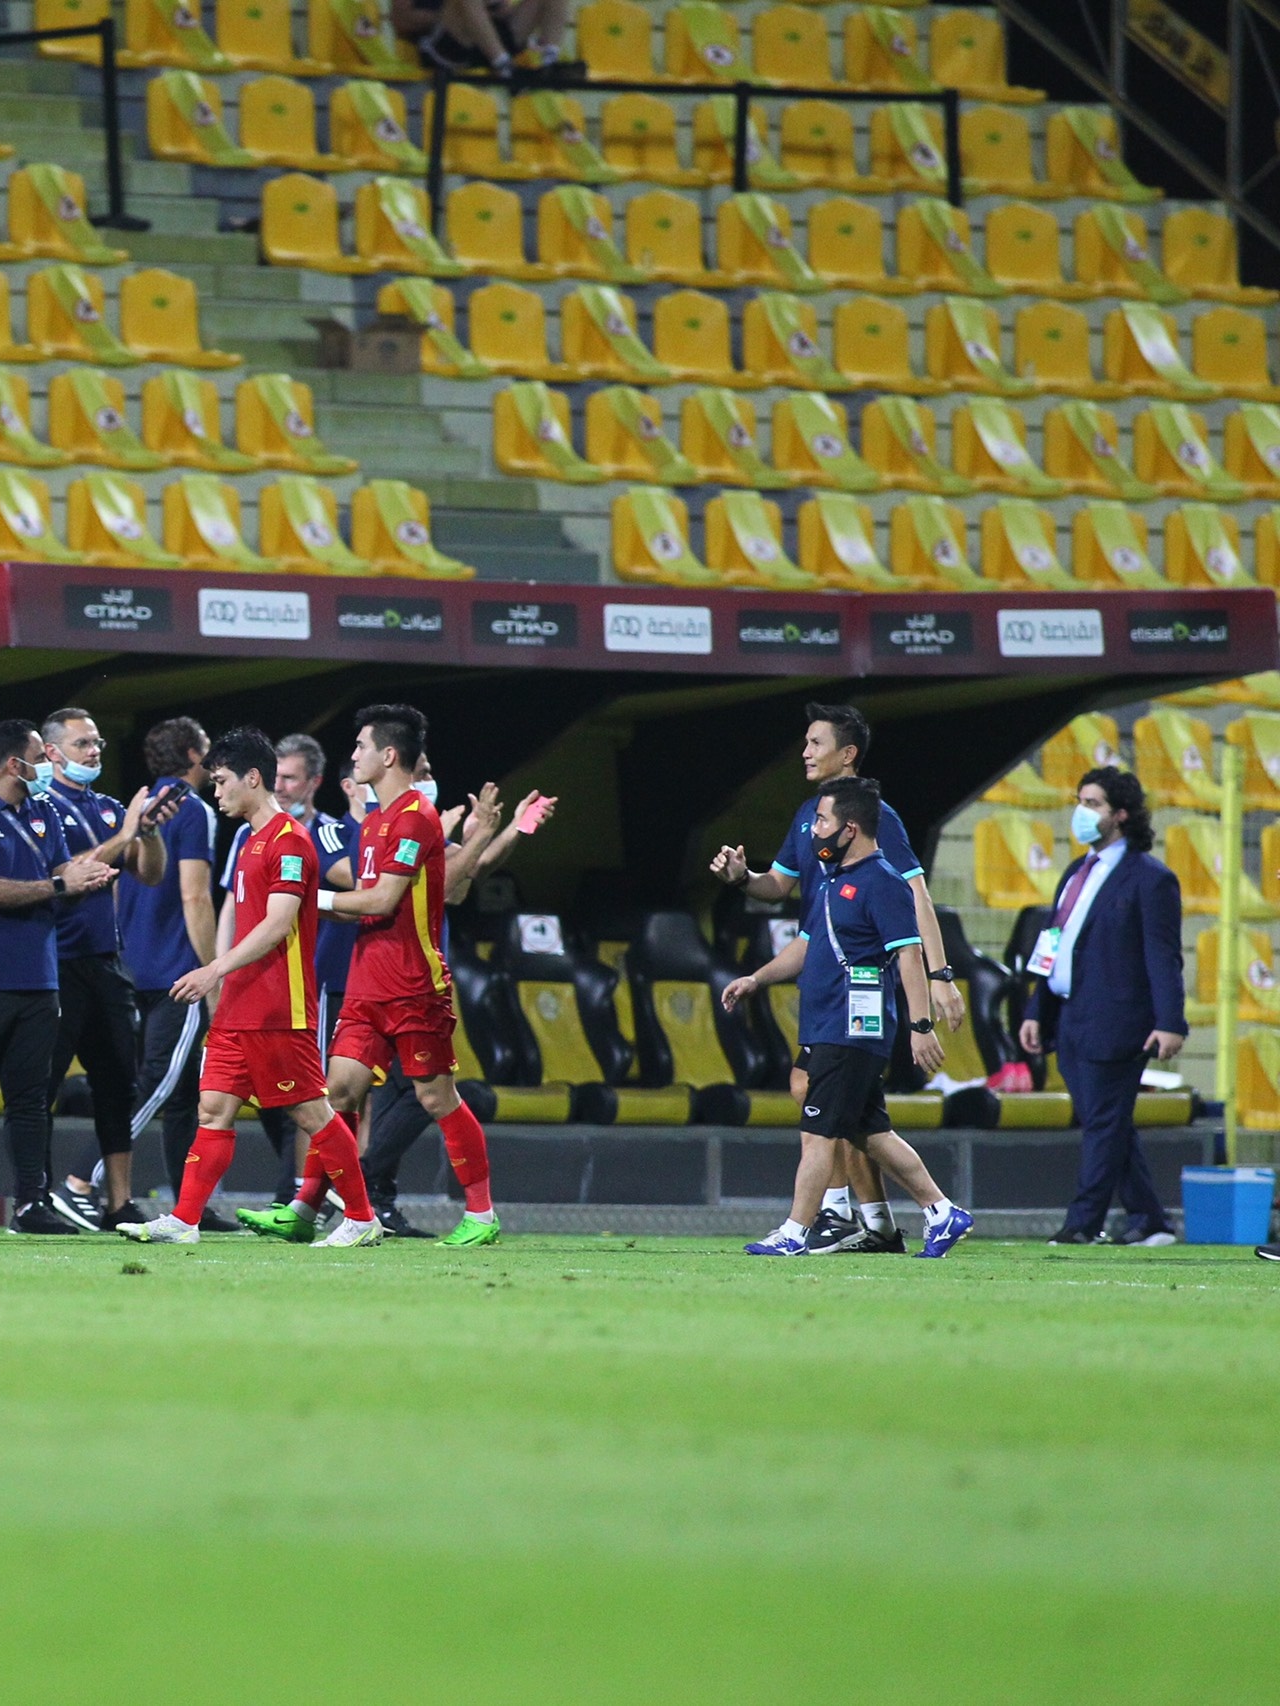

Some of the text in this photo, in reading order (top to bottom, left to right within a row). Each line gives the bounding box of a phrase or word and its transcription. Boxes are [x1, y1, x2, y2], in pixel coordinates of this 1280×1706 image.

[83, 604, 153, 620] ETIHAD
[491, 620, 559, 636] ETIHAD
[889, 629, 956, 645] ETIHAD
